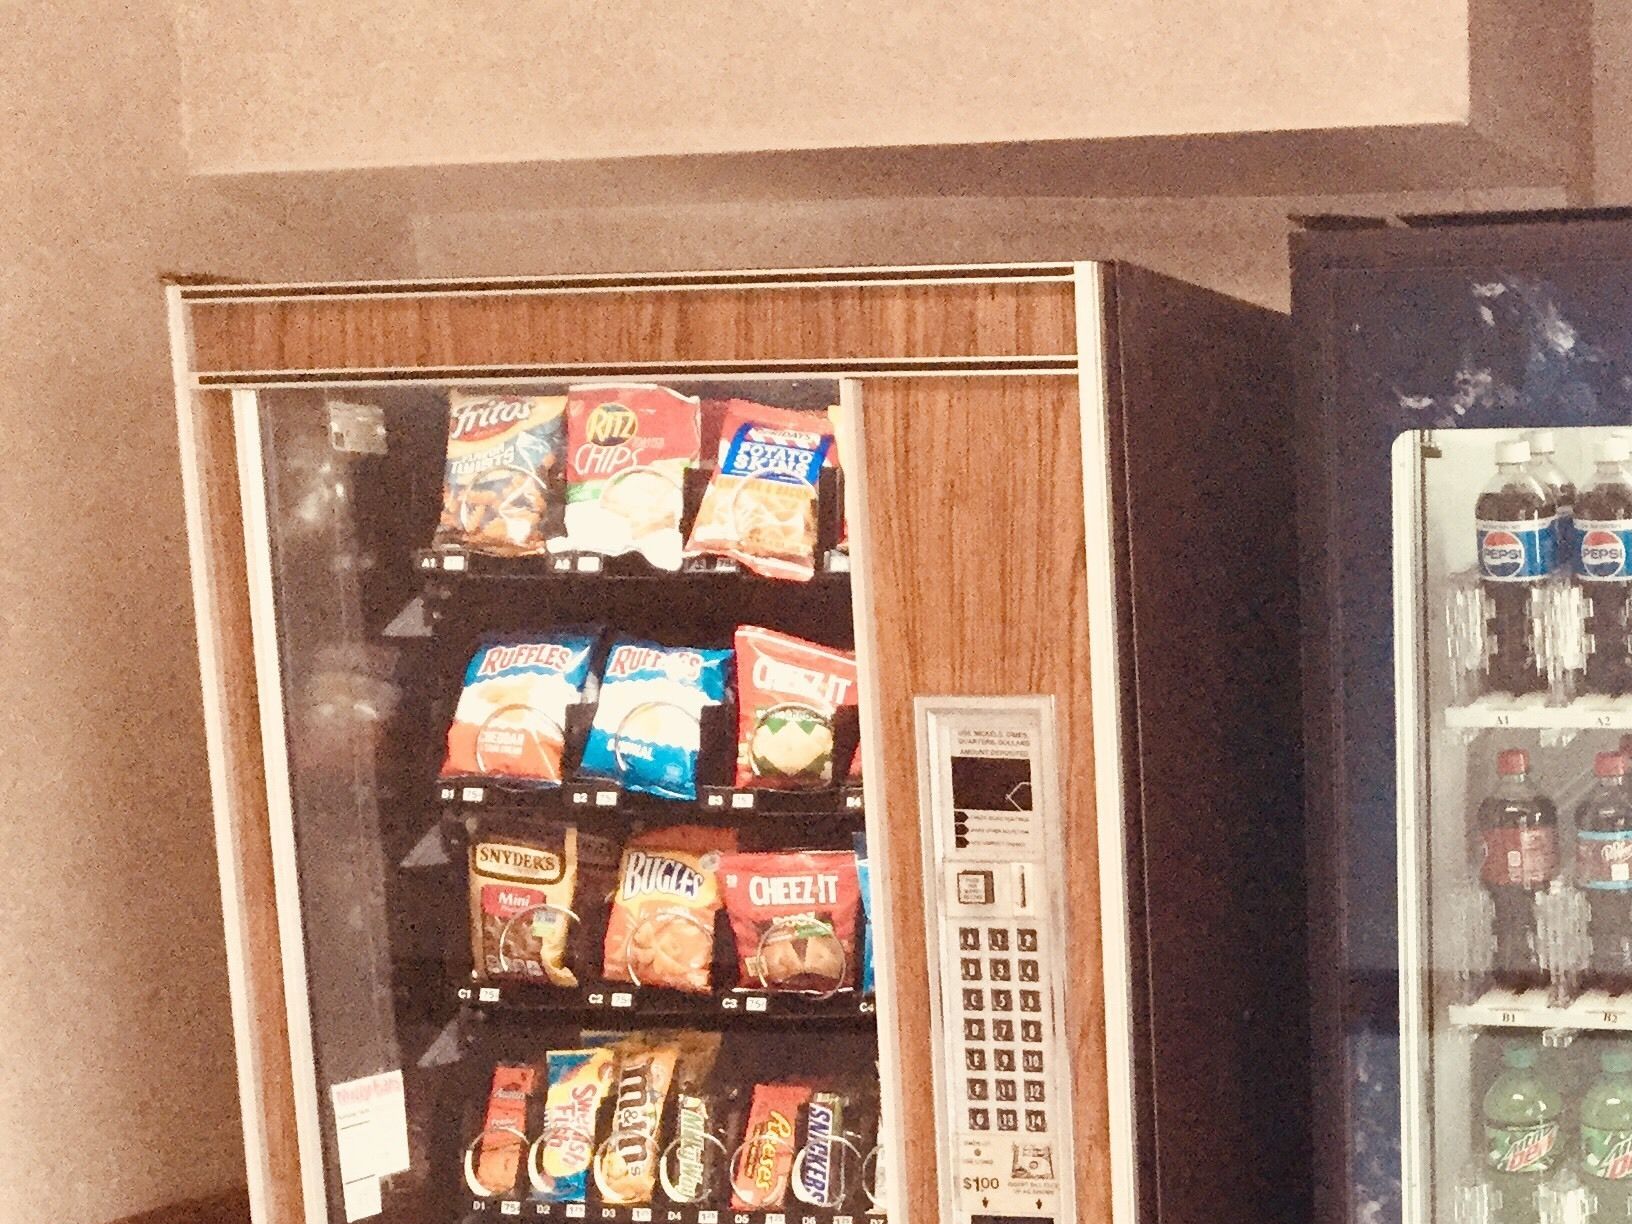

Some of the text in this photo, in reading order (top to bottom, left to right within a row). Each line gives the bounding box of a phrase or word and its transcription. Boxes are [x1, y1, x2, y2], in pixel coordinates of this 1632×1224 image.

[450, 400, 532, 440] Fritos
[588, 409, 637, 443] RITZ
[740, 441, 814, 464] POTATO
[575, 444, 644, 476] CHIPS
[1484, 547, 1523, 560] PEPSI
[1582, 547, 1623, 560] PEPSI
[483, 645, 571, 674] RUFFLES
[480, 847, 555, 871] SNYDER'S
[623, 851, 705, 901] BUGLES
[750, 874, 839, 905] CHEEZ-IT
[498, 892, 530, 906] Mini
[458, 988, 472, 999] C1
[588, 993, 604, 1004] C2
[722, 998, 738, 1009] C3
[804, 1103, 830, 1206] SNICKERS
[473, 1201, 486, 1210] D1
[536, 1204, 550, 1214] D2
[668, 1211, 682, 1221] D4
[734, 1215, 749, 1224] D5
